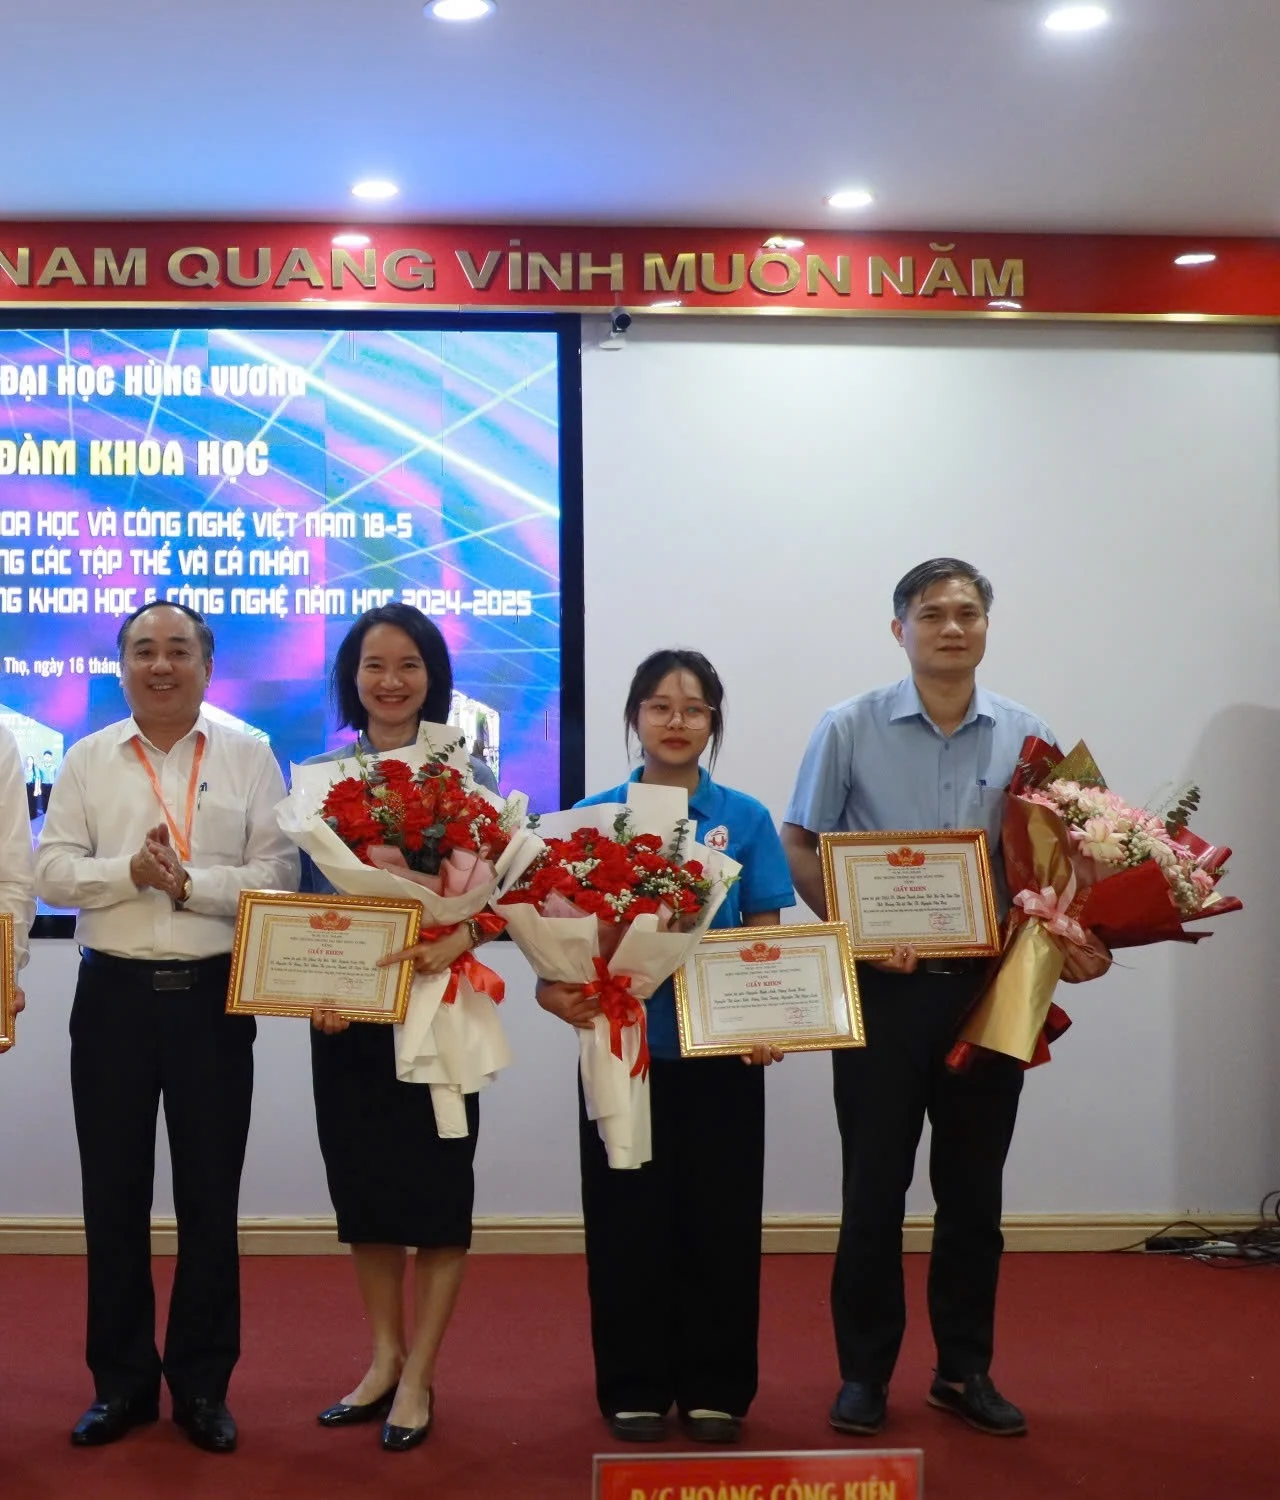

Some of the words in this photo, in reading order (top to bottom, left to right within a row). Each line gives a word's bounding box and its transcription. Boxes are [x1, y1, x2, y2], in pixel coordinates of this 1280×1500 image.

[166, 246, 436, 289] QUANG
[643, 236, 851, 295] MUÔN
[868, 243, 1025, 297] NĂM
[0, 364, 47, 402] ĐẠI
[57, 364, 114, 402] HỌC
[124, 359, 201, 397] HÙNG
[89, 440, 185, 476] KHOA
[198, 440, 269, 484] HỌC
[37, 510, 79, 542] HỌC
[87, 507, 118, 537] VÀ
[123, 507, 181, 537] CÔNG
[187, 507, 244, 542] NGHỆ
[252, 507, 297, 542] VIỆT
[305, 511, 357, 538] NAM
[31, 544, 72, 575] CÁC
[78, 545, 122, 580] TẬP
[130, 540, 171, 576] THỂ
[178, 545, 208, 576] VÀ
[214, 545, 244, 576] CÁ
[249, 545, 309, 576] NHÂN
[29, 588, 89, 614] KHOA
[94, 588, 137, 619] HỌC
[166, 584, 224, 614] CÔNG
[230, 584, 288, 618] NGHỆ
[295, 586, 345, 615] NĂM
[401, 588, 532, 616] 2024-2025
[4, 656, 30, 676] Thọ,
[34, 656, 64, 677] ngày
[69, 657, 84, 674] 16
